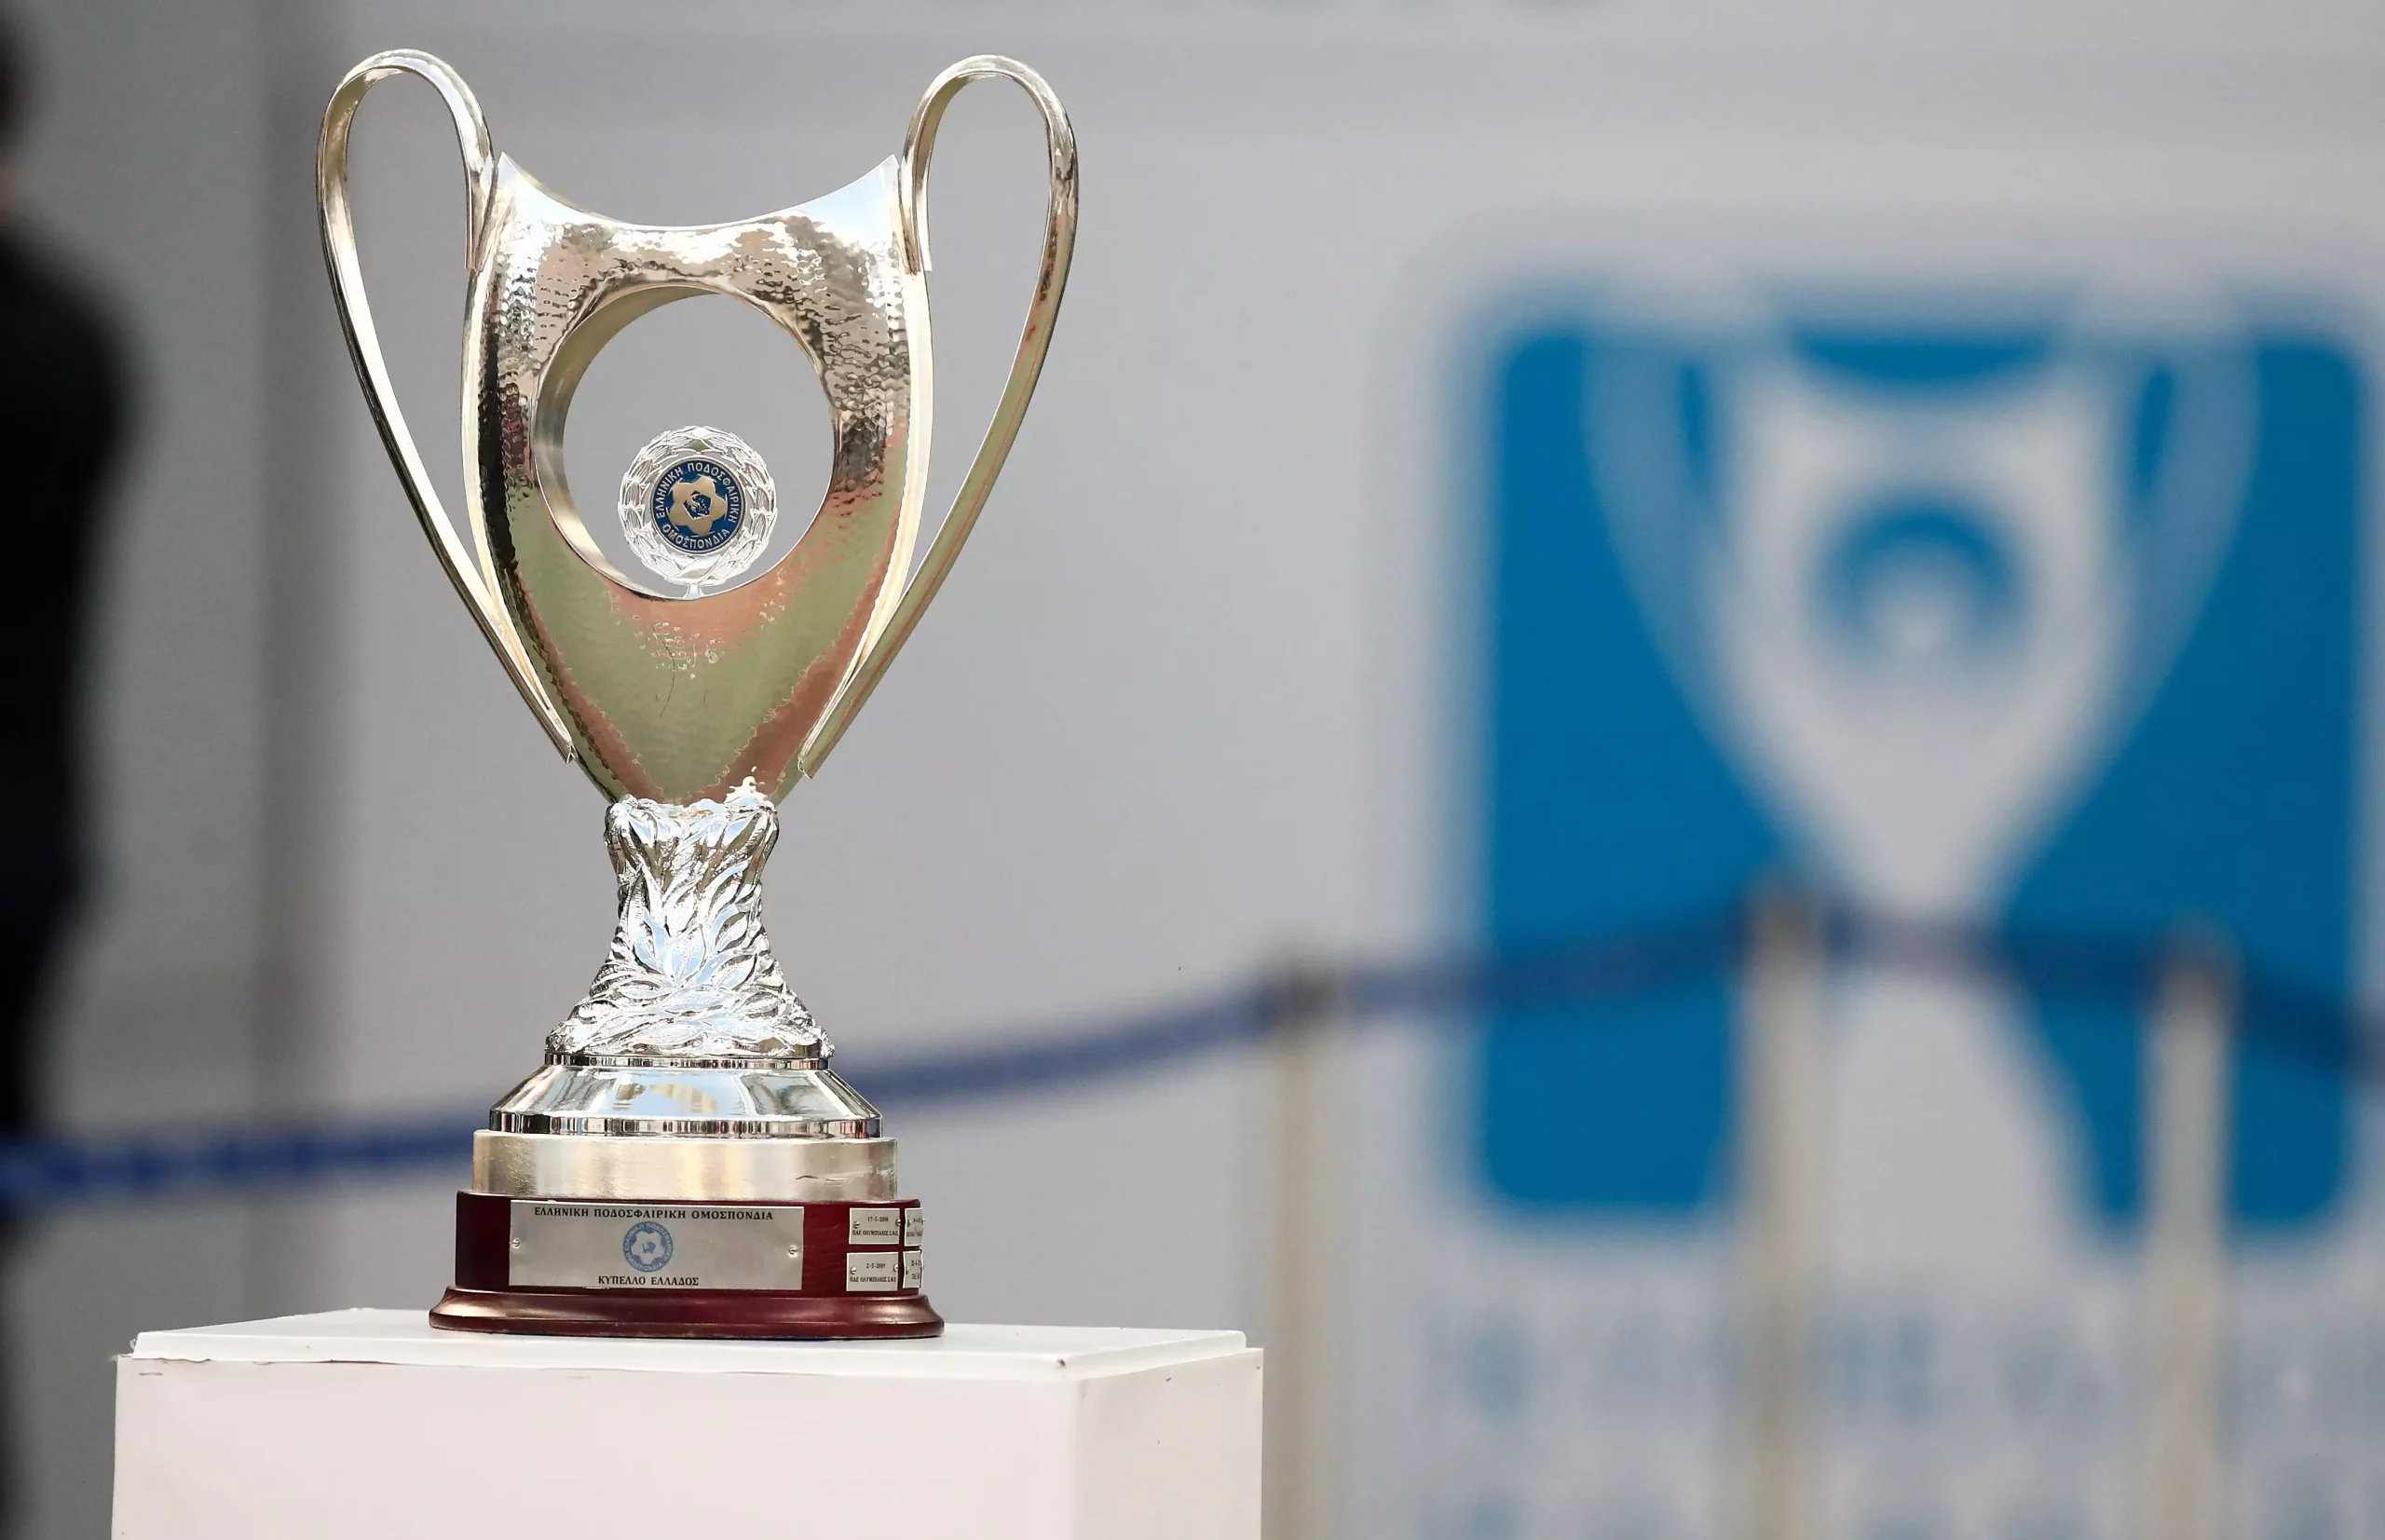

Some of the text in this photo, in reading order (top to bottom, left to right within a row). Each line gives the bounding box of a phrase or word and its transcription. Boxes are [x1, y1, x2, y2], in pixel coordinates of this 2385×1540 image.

[655, 462, 740, 524] ΕΛΛΗΝΙΚΗ ΠΟΔΟΣΦΑΙΡΙΚΗ
[661, 524, 730, 549] ΟΜΟΣΠΟΝΔΙΑ
[534, 1206, 589, 1217] ΕΛΛΗΝΙΚΗ
[691, 1210, 773, 1220] ΟΜΟΣΠΟΝΔΙΑ
[598, 1275, 700, 1286] ΚΥΠΕΛΛΟ ΕΛΛΑΔΟΣ
